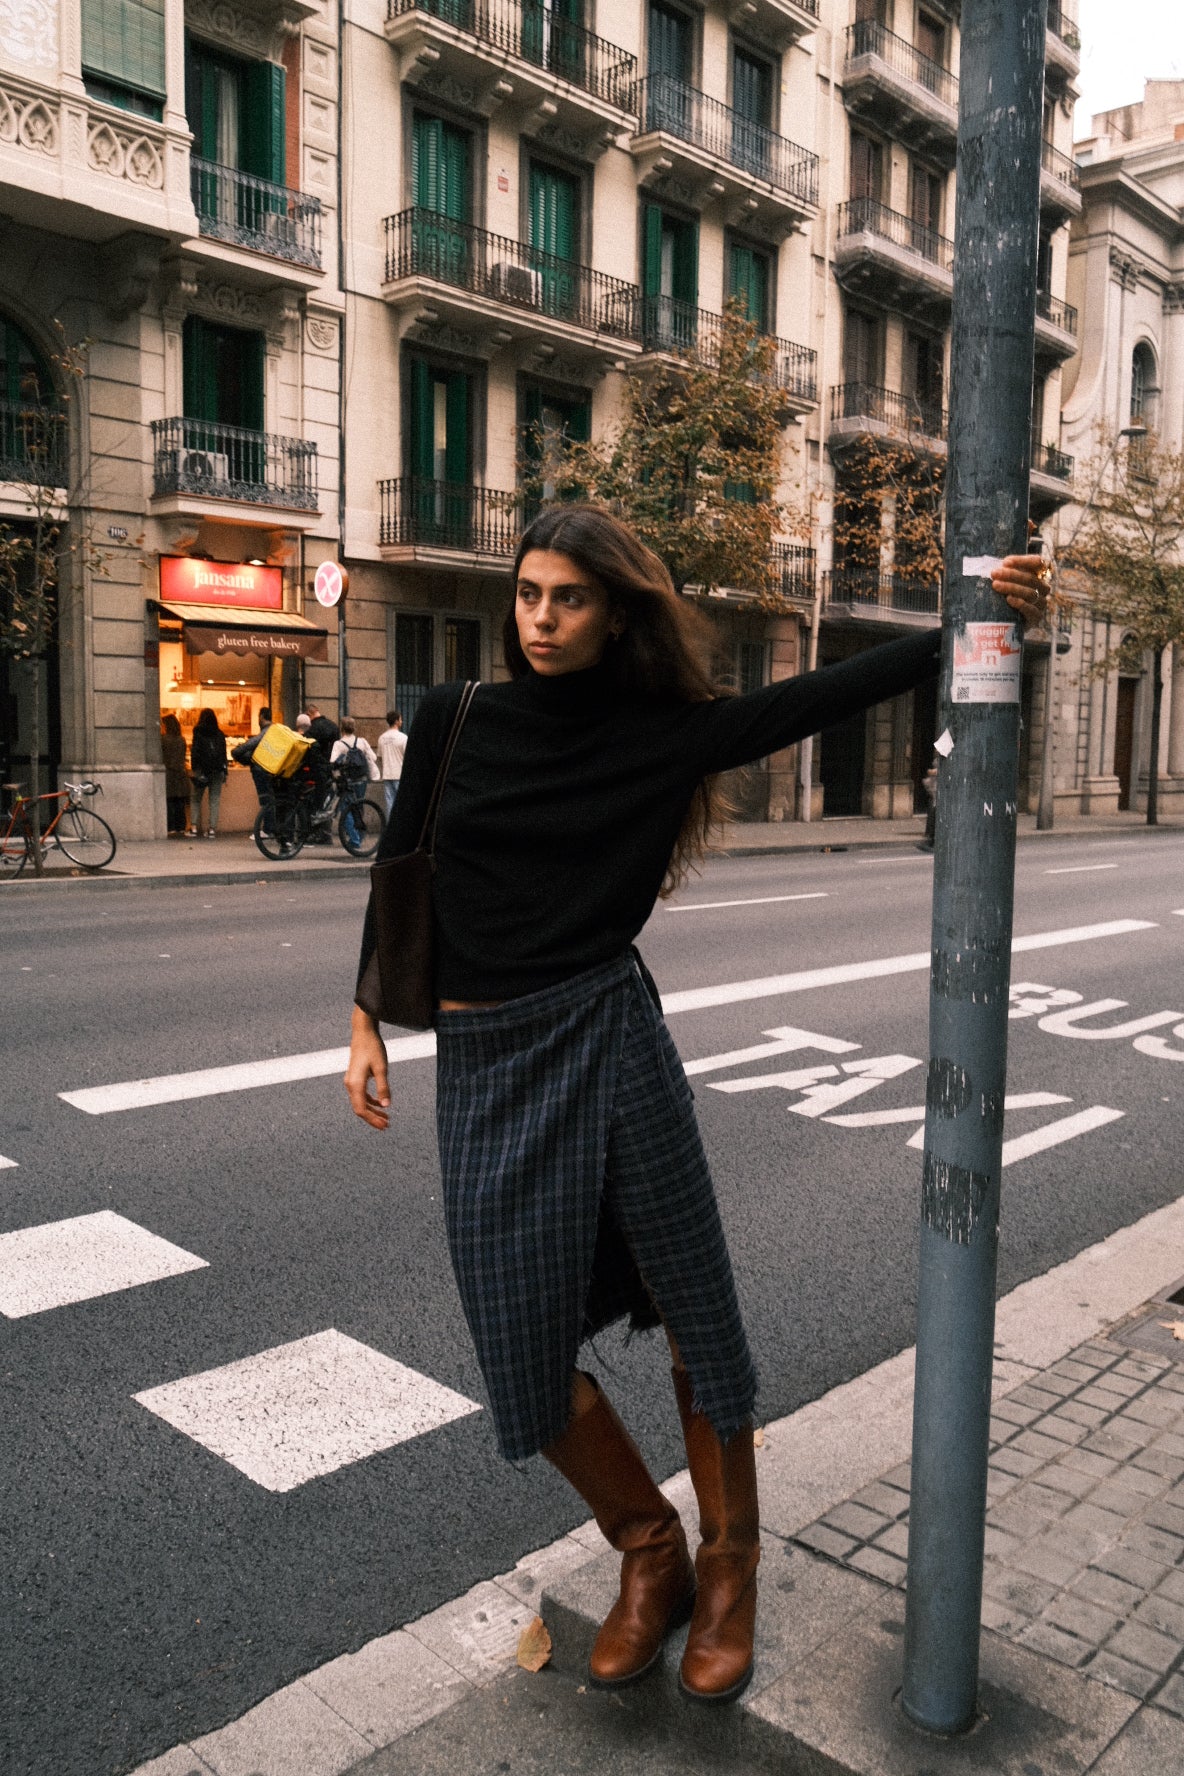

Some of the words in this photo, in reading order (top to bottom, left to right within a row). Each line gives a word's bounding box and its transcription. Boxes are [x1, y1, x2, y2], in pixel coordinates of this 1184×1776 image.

[217, 633, 249, 649] gluten
[250, 635, 269, 648] free
[269, 636, 301, 653] bakery
